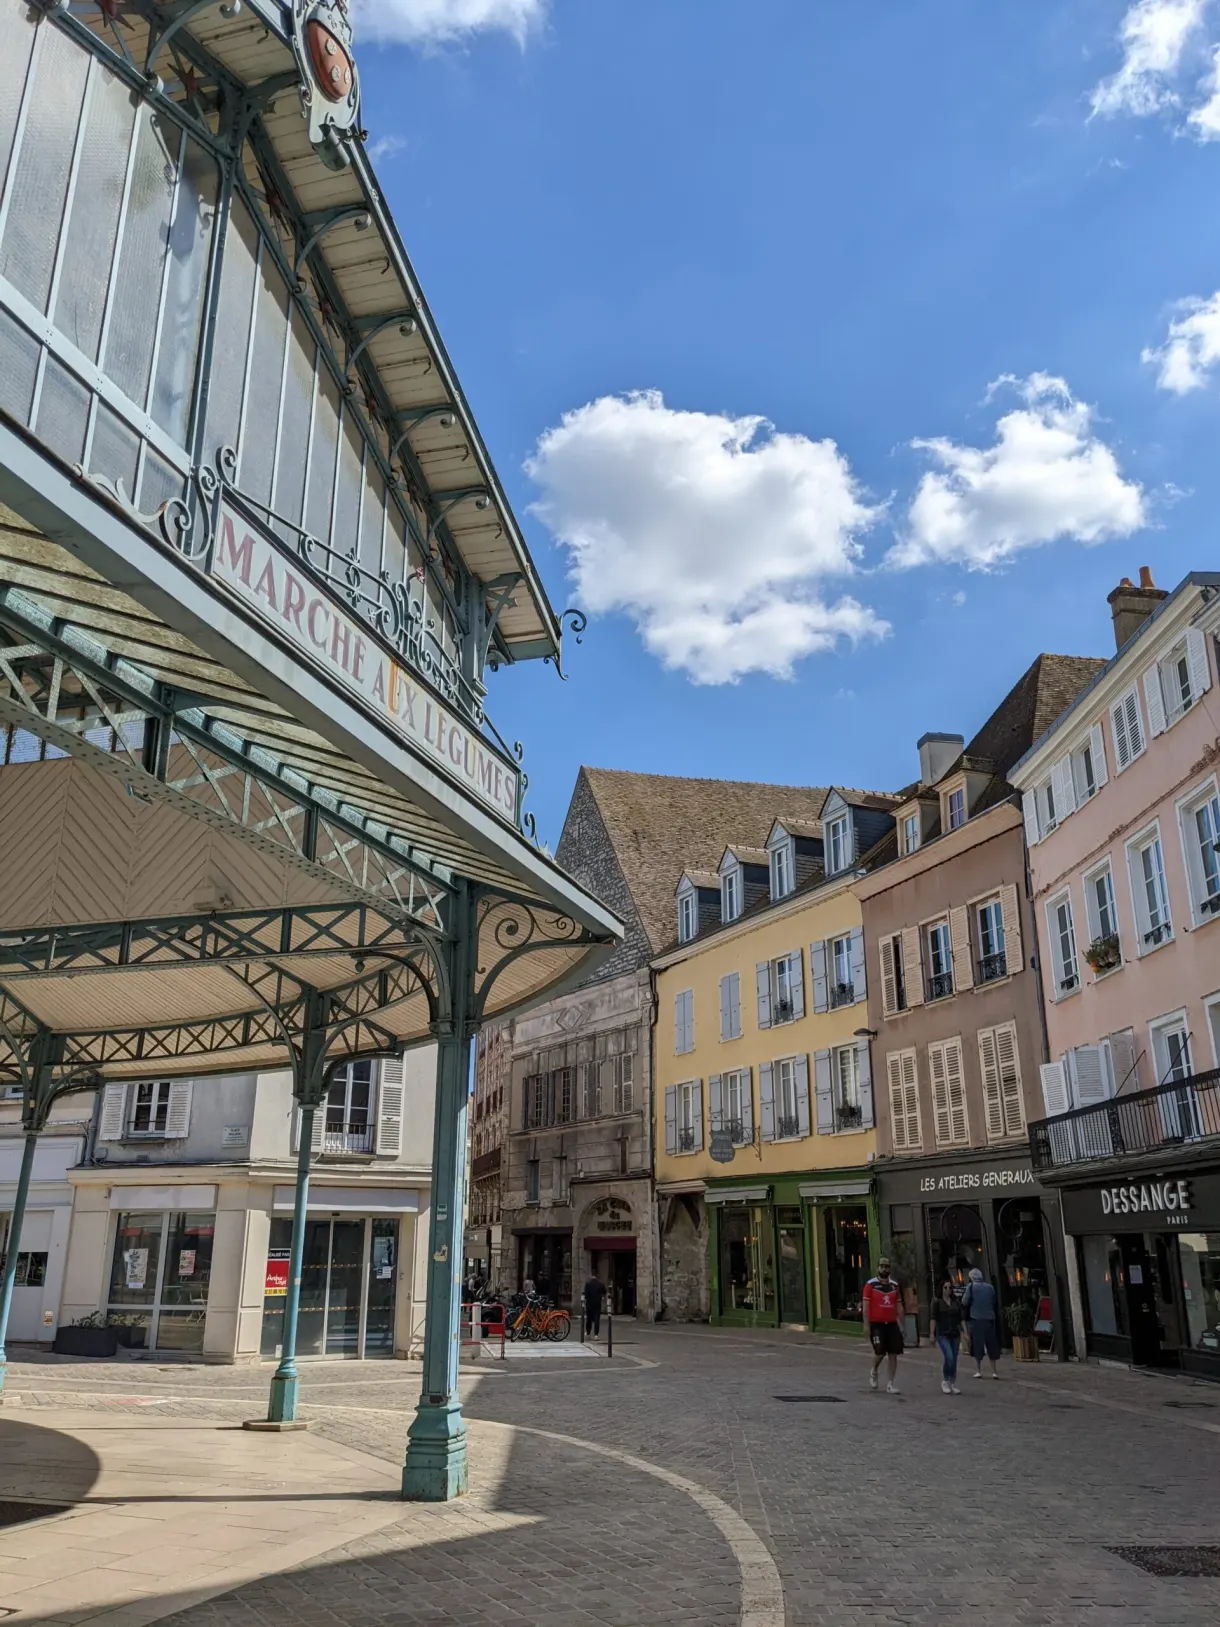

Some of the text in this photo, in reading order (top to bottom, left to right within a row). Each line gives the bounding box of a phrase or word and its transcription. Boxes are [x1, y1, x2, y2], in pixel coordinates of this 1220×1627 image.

[216, 511, 514, 811] MARCHE AUX LEGUMES
[920, 1169, 1035, 1191] LES ATELIERS GENERAUX
[1101, 1180, 1190, 1214] DESSANGE
[1166, 1215, 1189, 1225] PARIS
